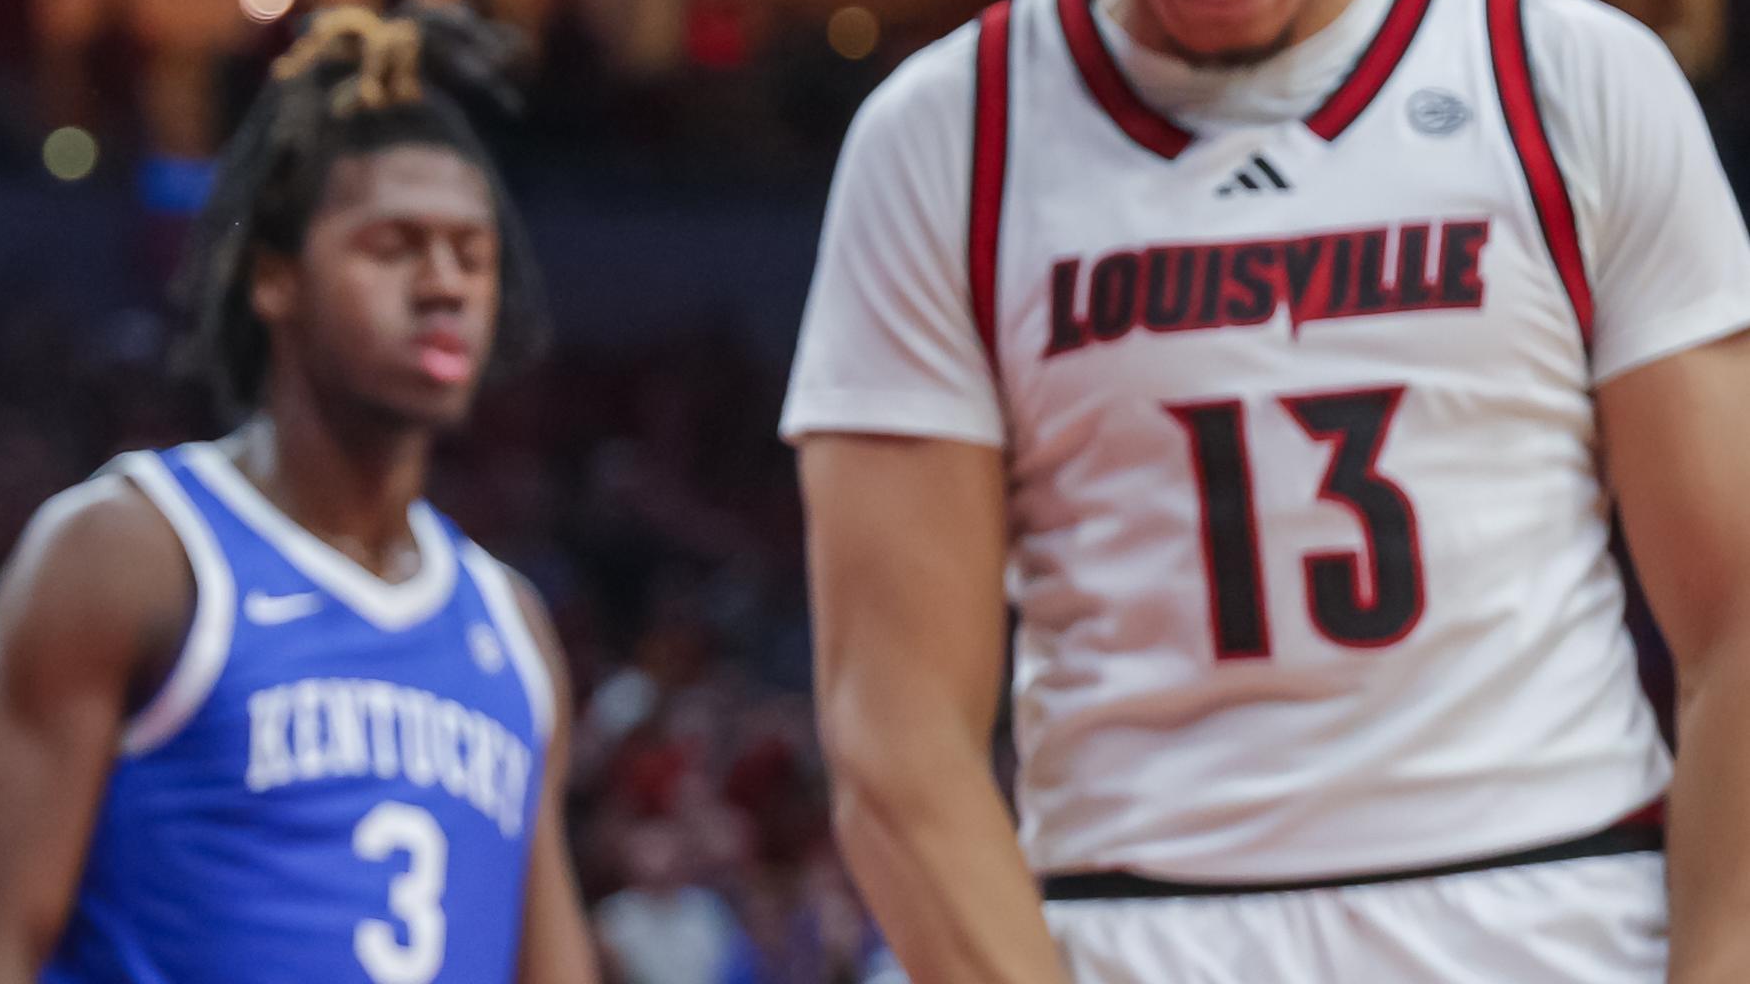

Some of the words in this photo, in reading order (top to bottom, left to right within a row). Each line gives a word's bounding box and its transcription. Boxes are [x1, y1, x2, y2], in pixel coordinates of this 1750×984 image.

[1043, 218, 1490, 361] LOUISVILLE
[1161, 384, 1426, 661] 13
[247, 677, 531, 840] KENTUCKY
[353, 800, 449, 984] 3
